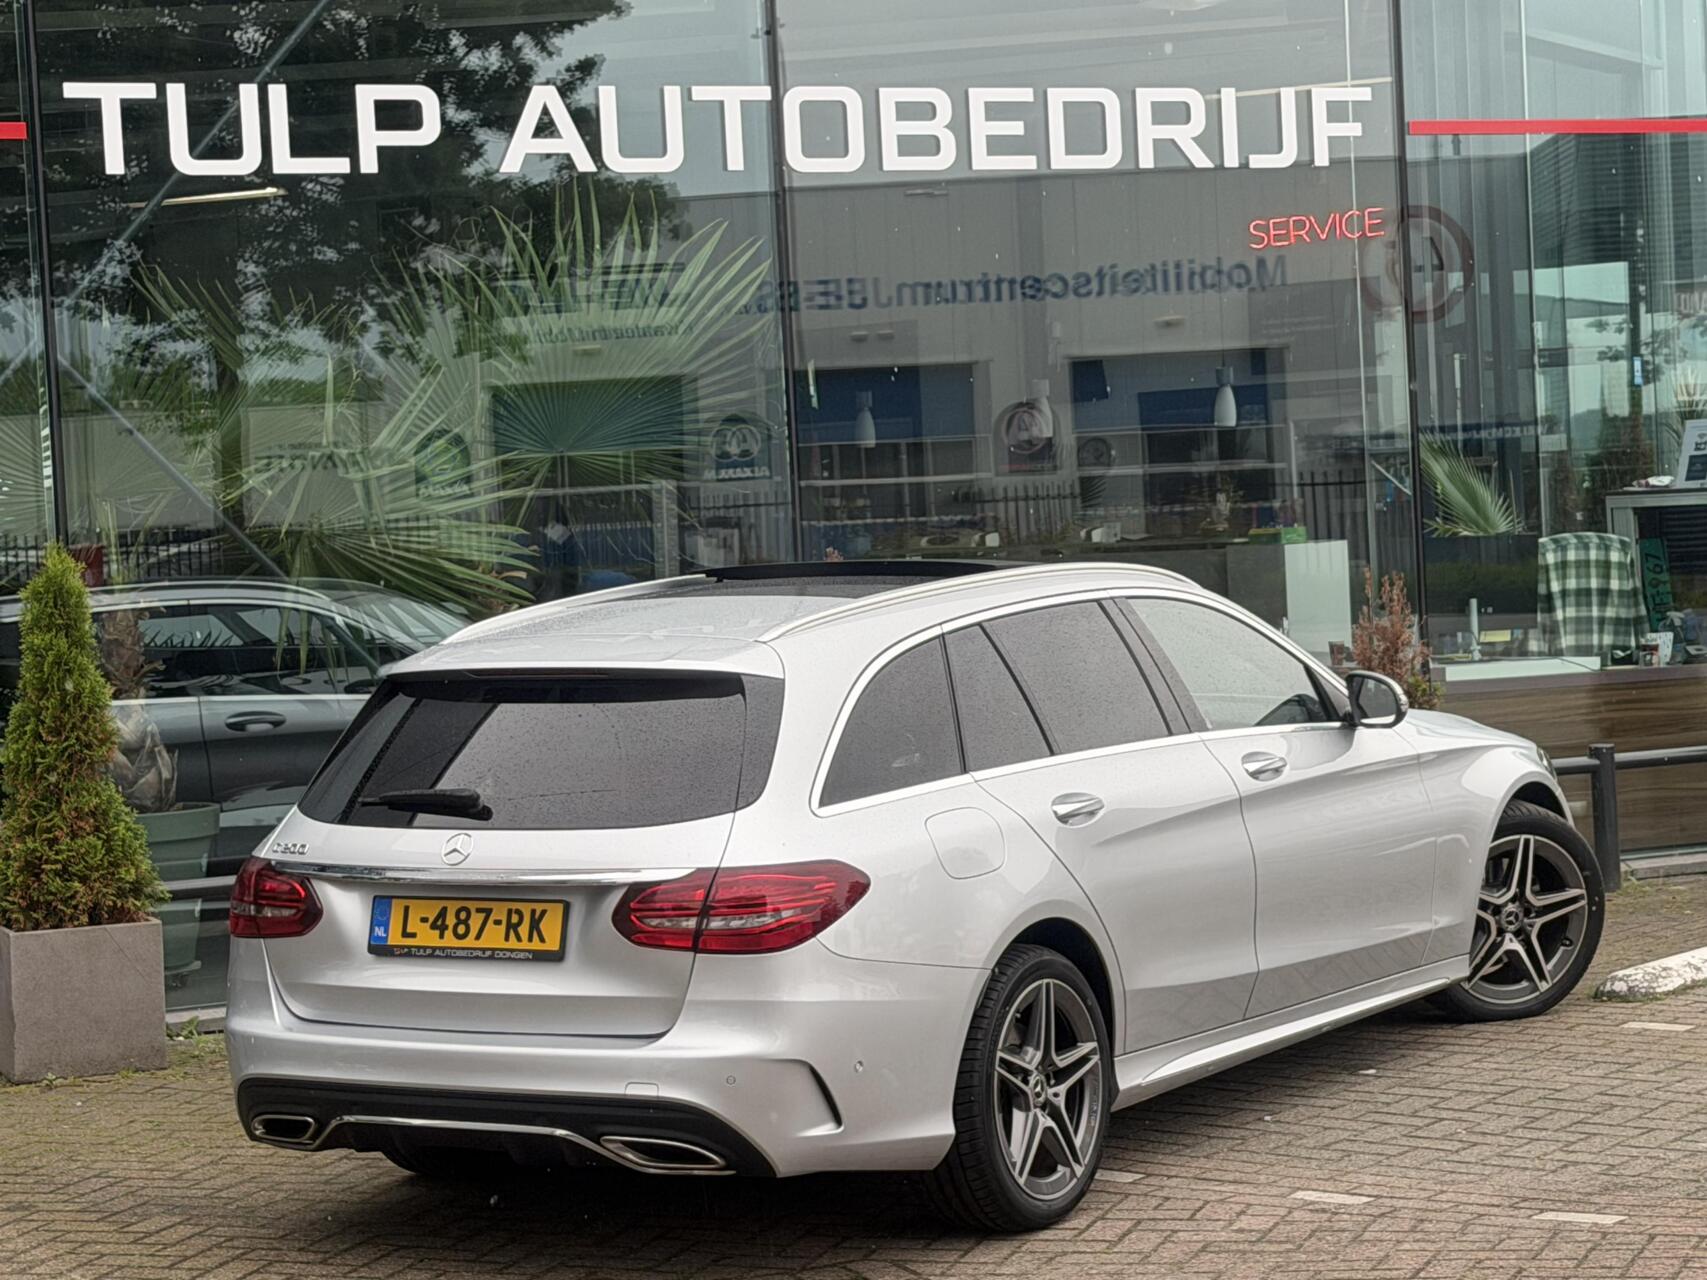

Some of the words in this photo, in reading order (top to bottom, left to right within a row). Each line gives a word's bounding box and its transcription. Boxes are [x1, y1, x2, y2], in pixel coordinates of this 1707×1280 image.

[62, 82, 441, 176] TULP
[499, 84, 1373, 174] AUTOBEDRIJF
[1248, 207, 1385, 249] SERVICE
[374, 926, 387, 938] NL
[401, 905, 548, 944] L-487-RK
[411, 948, 433, 956] TULP
[494, 951, 533, 959] DONGEN
